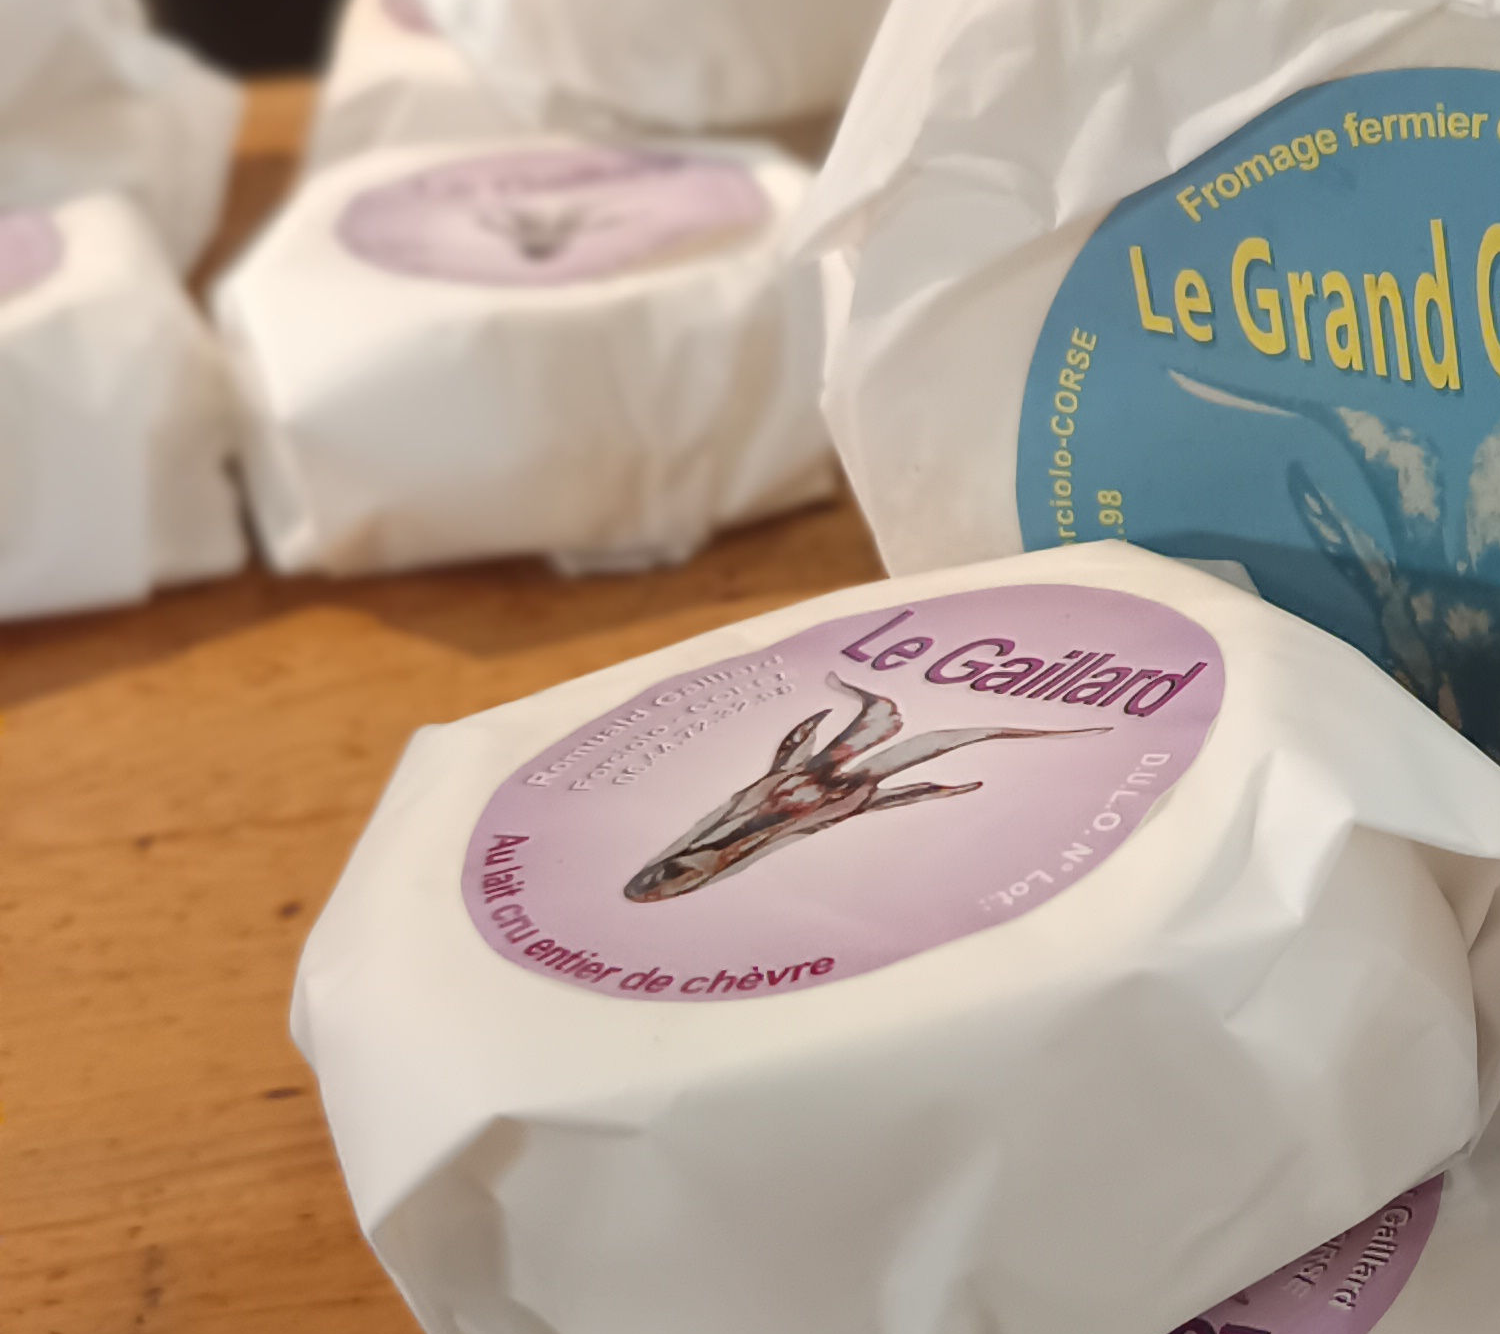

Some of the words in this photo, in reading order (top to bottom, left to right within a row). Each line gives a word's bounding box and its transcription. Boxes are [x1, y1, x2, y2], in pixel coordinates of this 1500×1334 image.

[1176, 128, 1338, 222] Fromage
[1343, 102, 1488, 147] fermier
[1129, 246, 1214, 342] Le
[1231, 219, 1462, 390] Grand
[1049, 327, 1097, 546] rciolo-CORSE
[840, 610, 934, 671] Le
[925, 638, 1208, 717] Gaillard
[484, 834, 530, 866] Au
[482, 865, 525, 904] lait
[491, 903, 540, 944] cru
[523, 938, 623, 984] entier
[618, 967, 674, 994] de
[679, 956, 836, 994] chèvre
[1328, 1205, 1414, 1311] Gaillard
